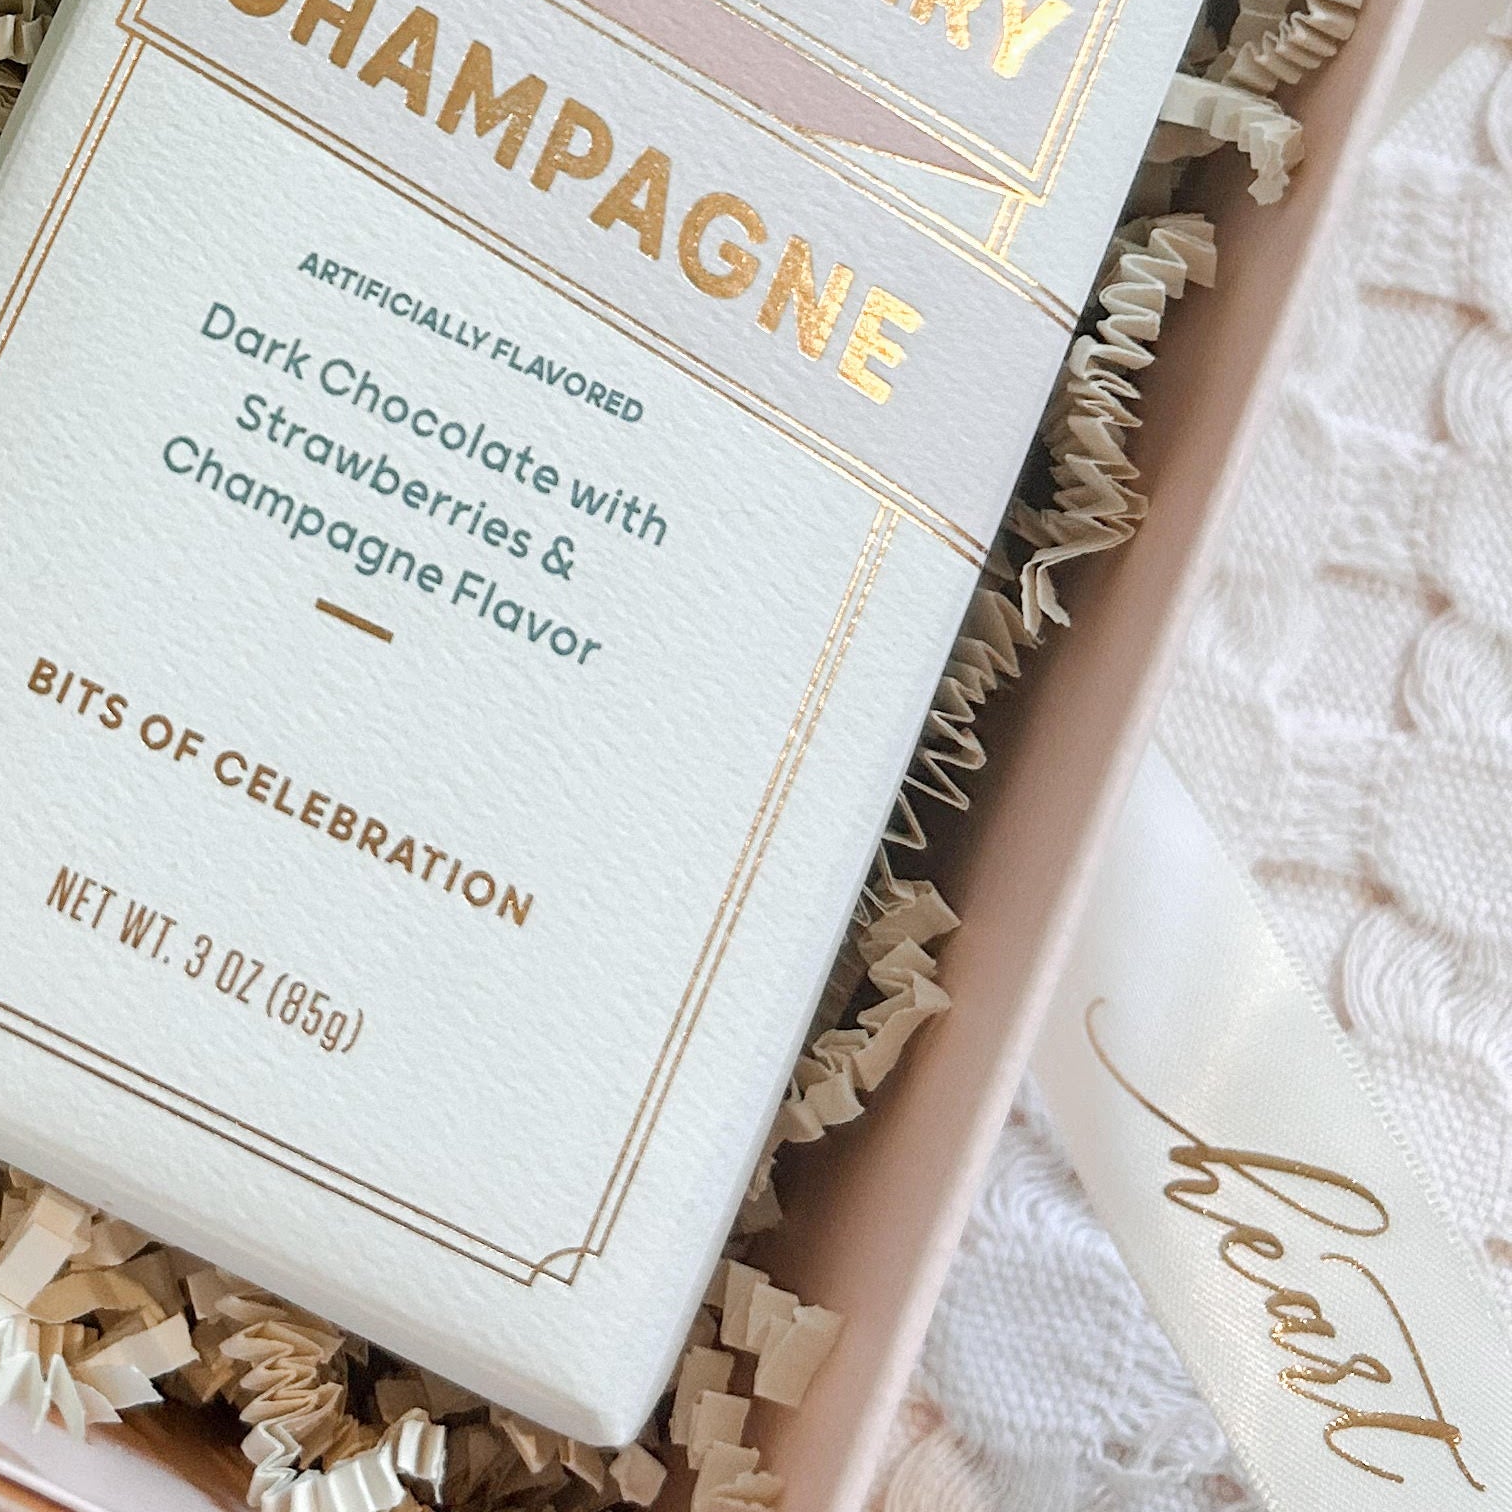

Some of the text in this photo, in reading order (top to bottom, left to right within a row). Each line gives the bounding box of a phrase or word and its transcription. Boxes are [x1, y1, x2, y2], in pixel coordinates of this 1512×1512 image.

[200, 301, 670, 548] Dark Chocolate with
[297, 251, 645, 423] ARTIFICIALLY FLAVORED
[162, 434, 603, 666] Champagne Flavor
[235, 393, 576, 580] Strawberries &
[27, 656, 535, 928] BITS OF CELEBRATION
[45, 864, 365, 1054] NET WT. 3 OZ (85g)
[1085, 996, 1486, 1493] heart
